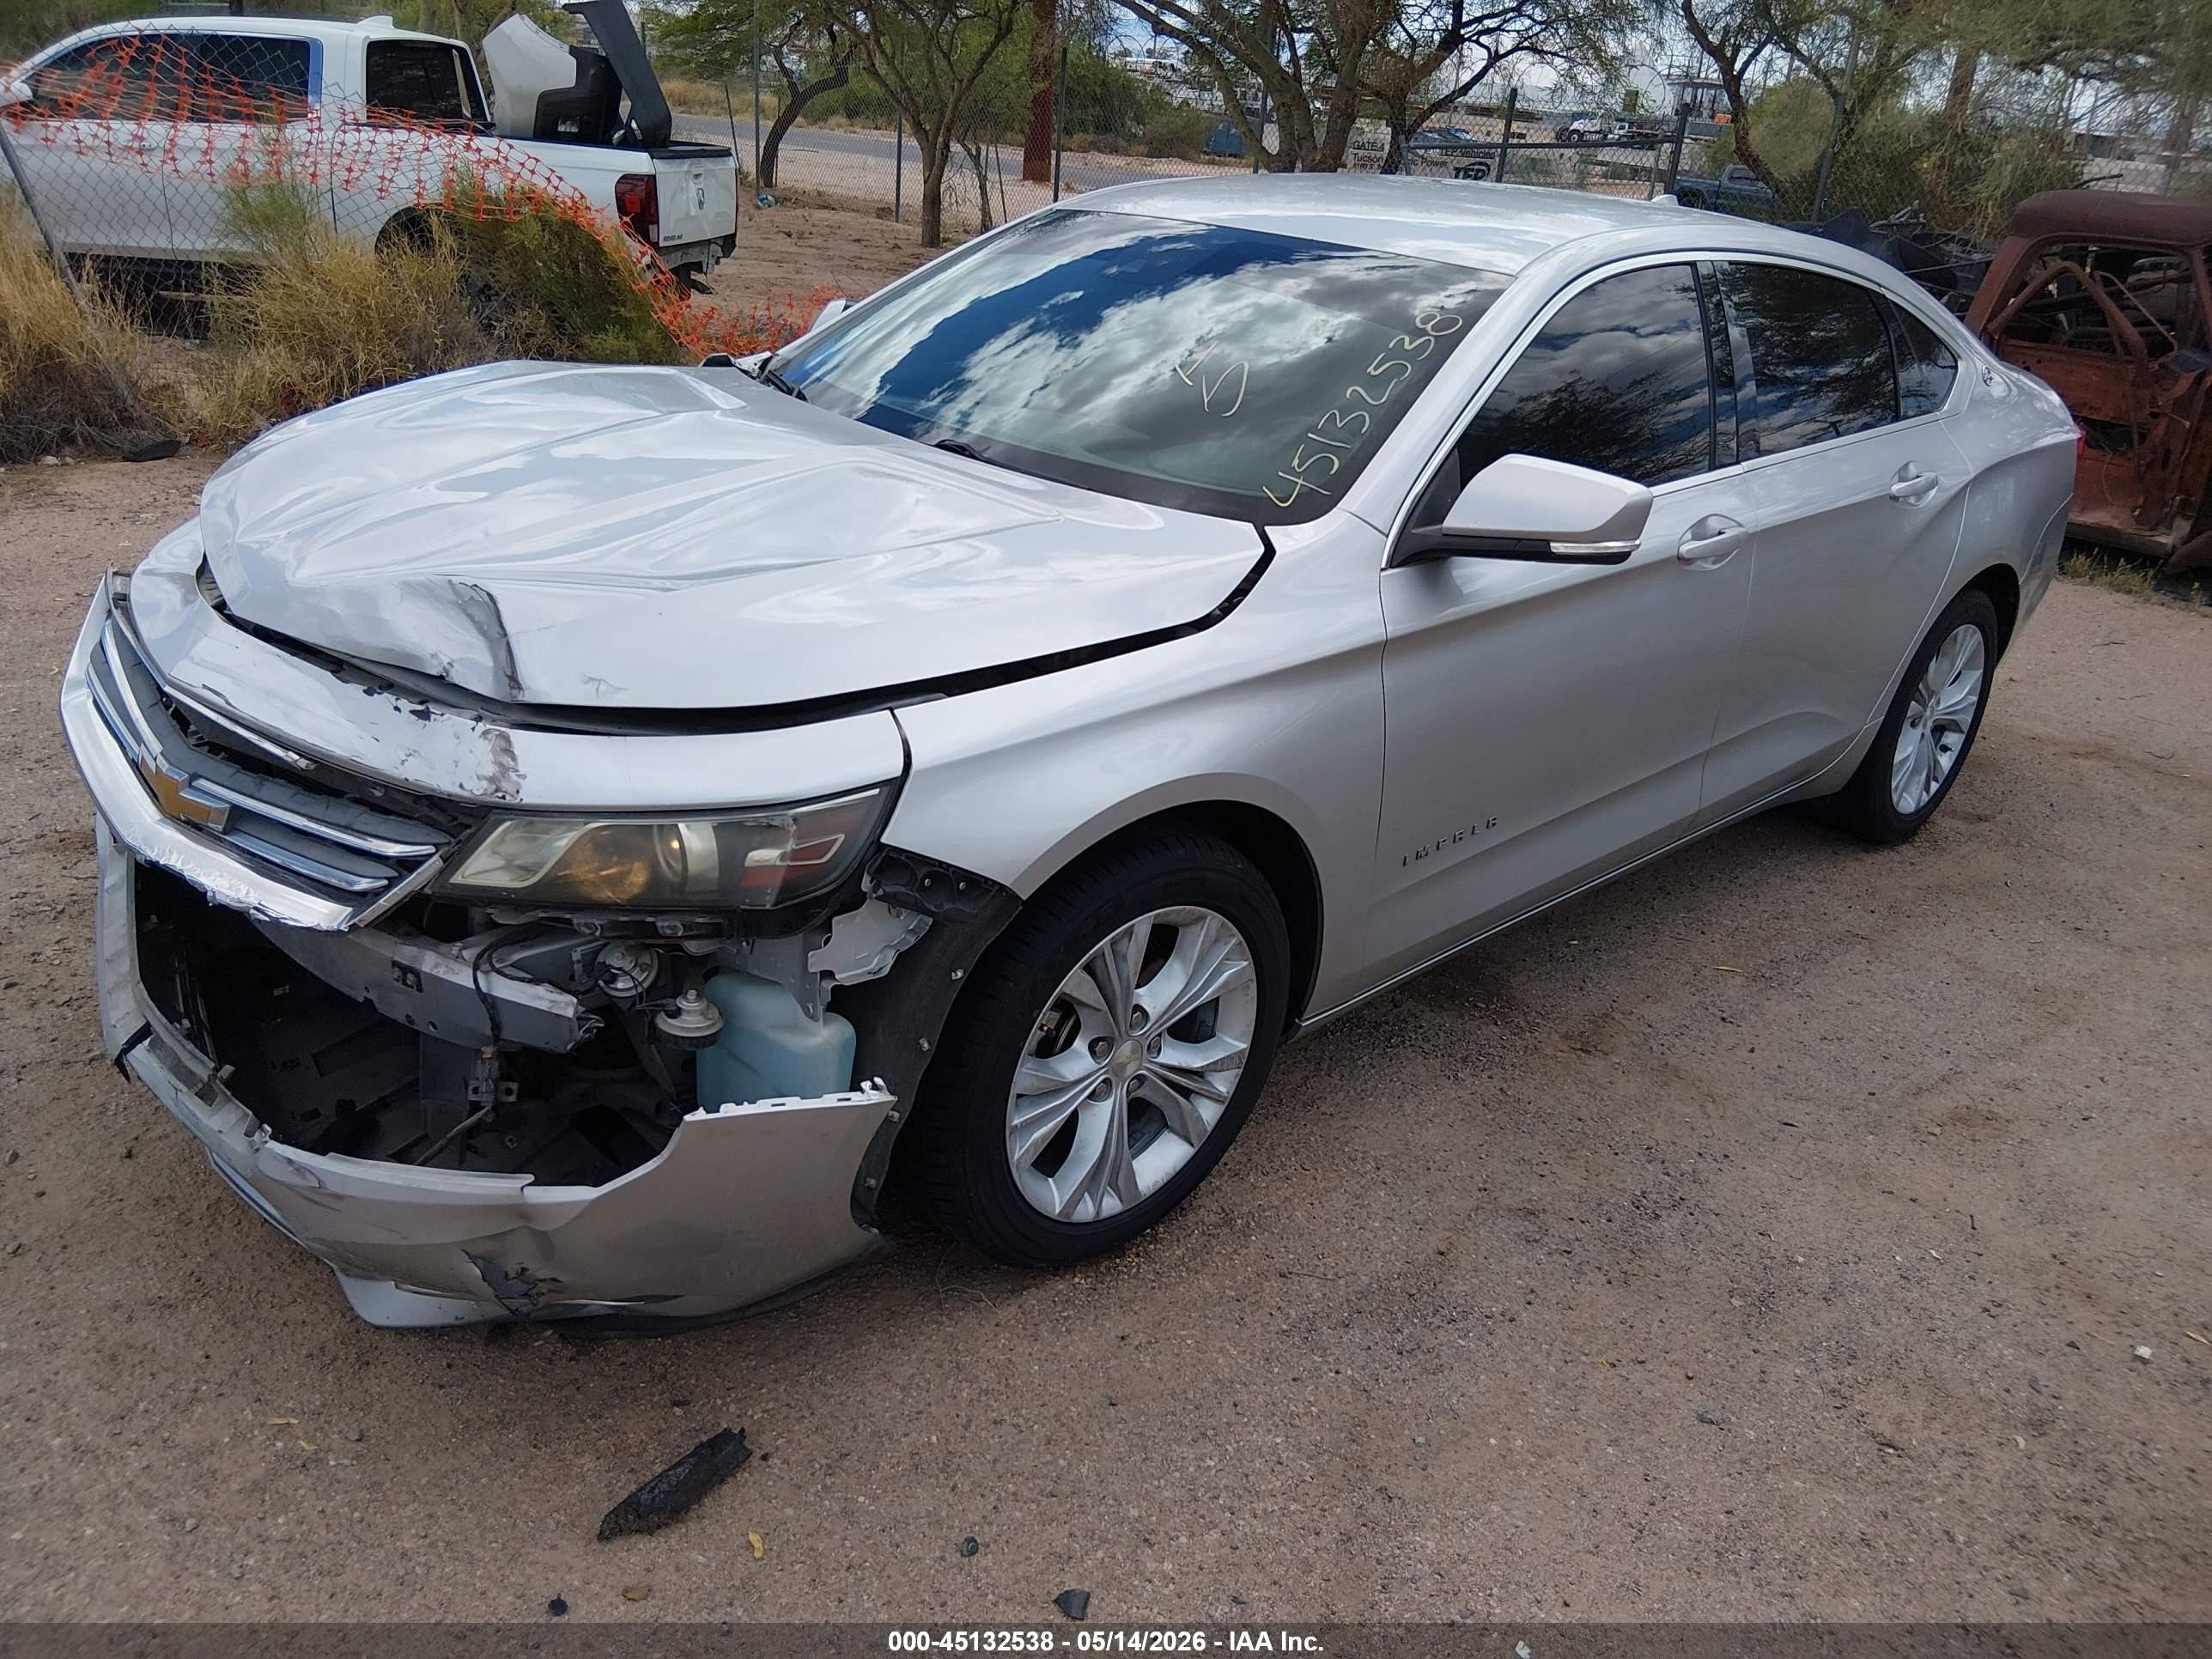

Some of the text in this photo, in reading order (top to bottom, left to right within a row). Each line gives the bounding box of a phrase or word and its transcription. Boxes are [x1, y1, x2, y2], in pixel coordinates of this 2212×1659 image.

[1352, 140, 1377, 150] GATE
[1352, 153, 1384, 164] Tucson
[1421, 157, 1449, 168] Power
[1453, 166, 1487, 180] TEP
[1263, 312, 1462, 507] 45132538
